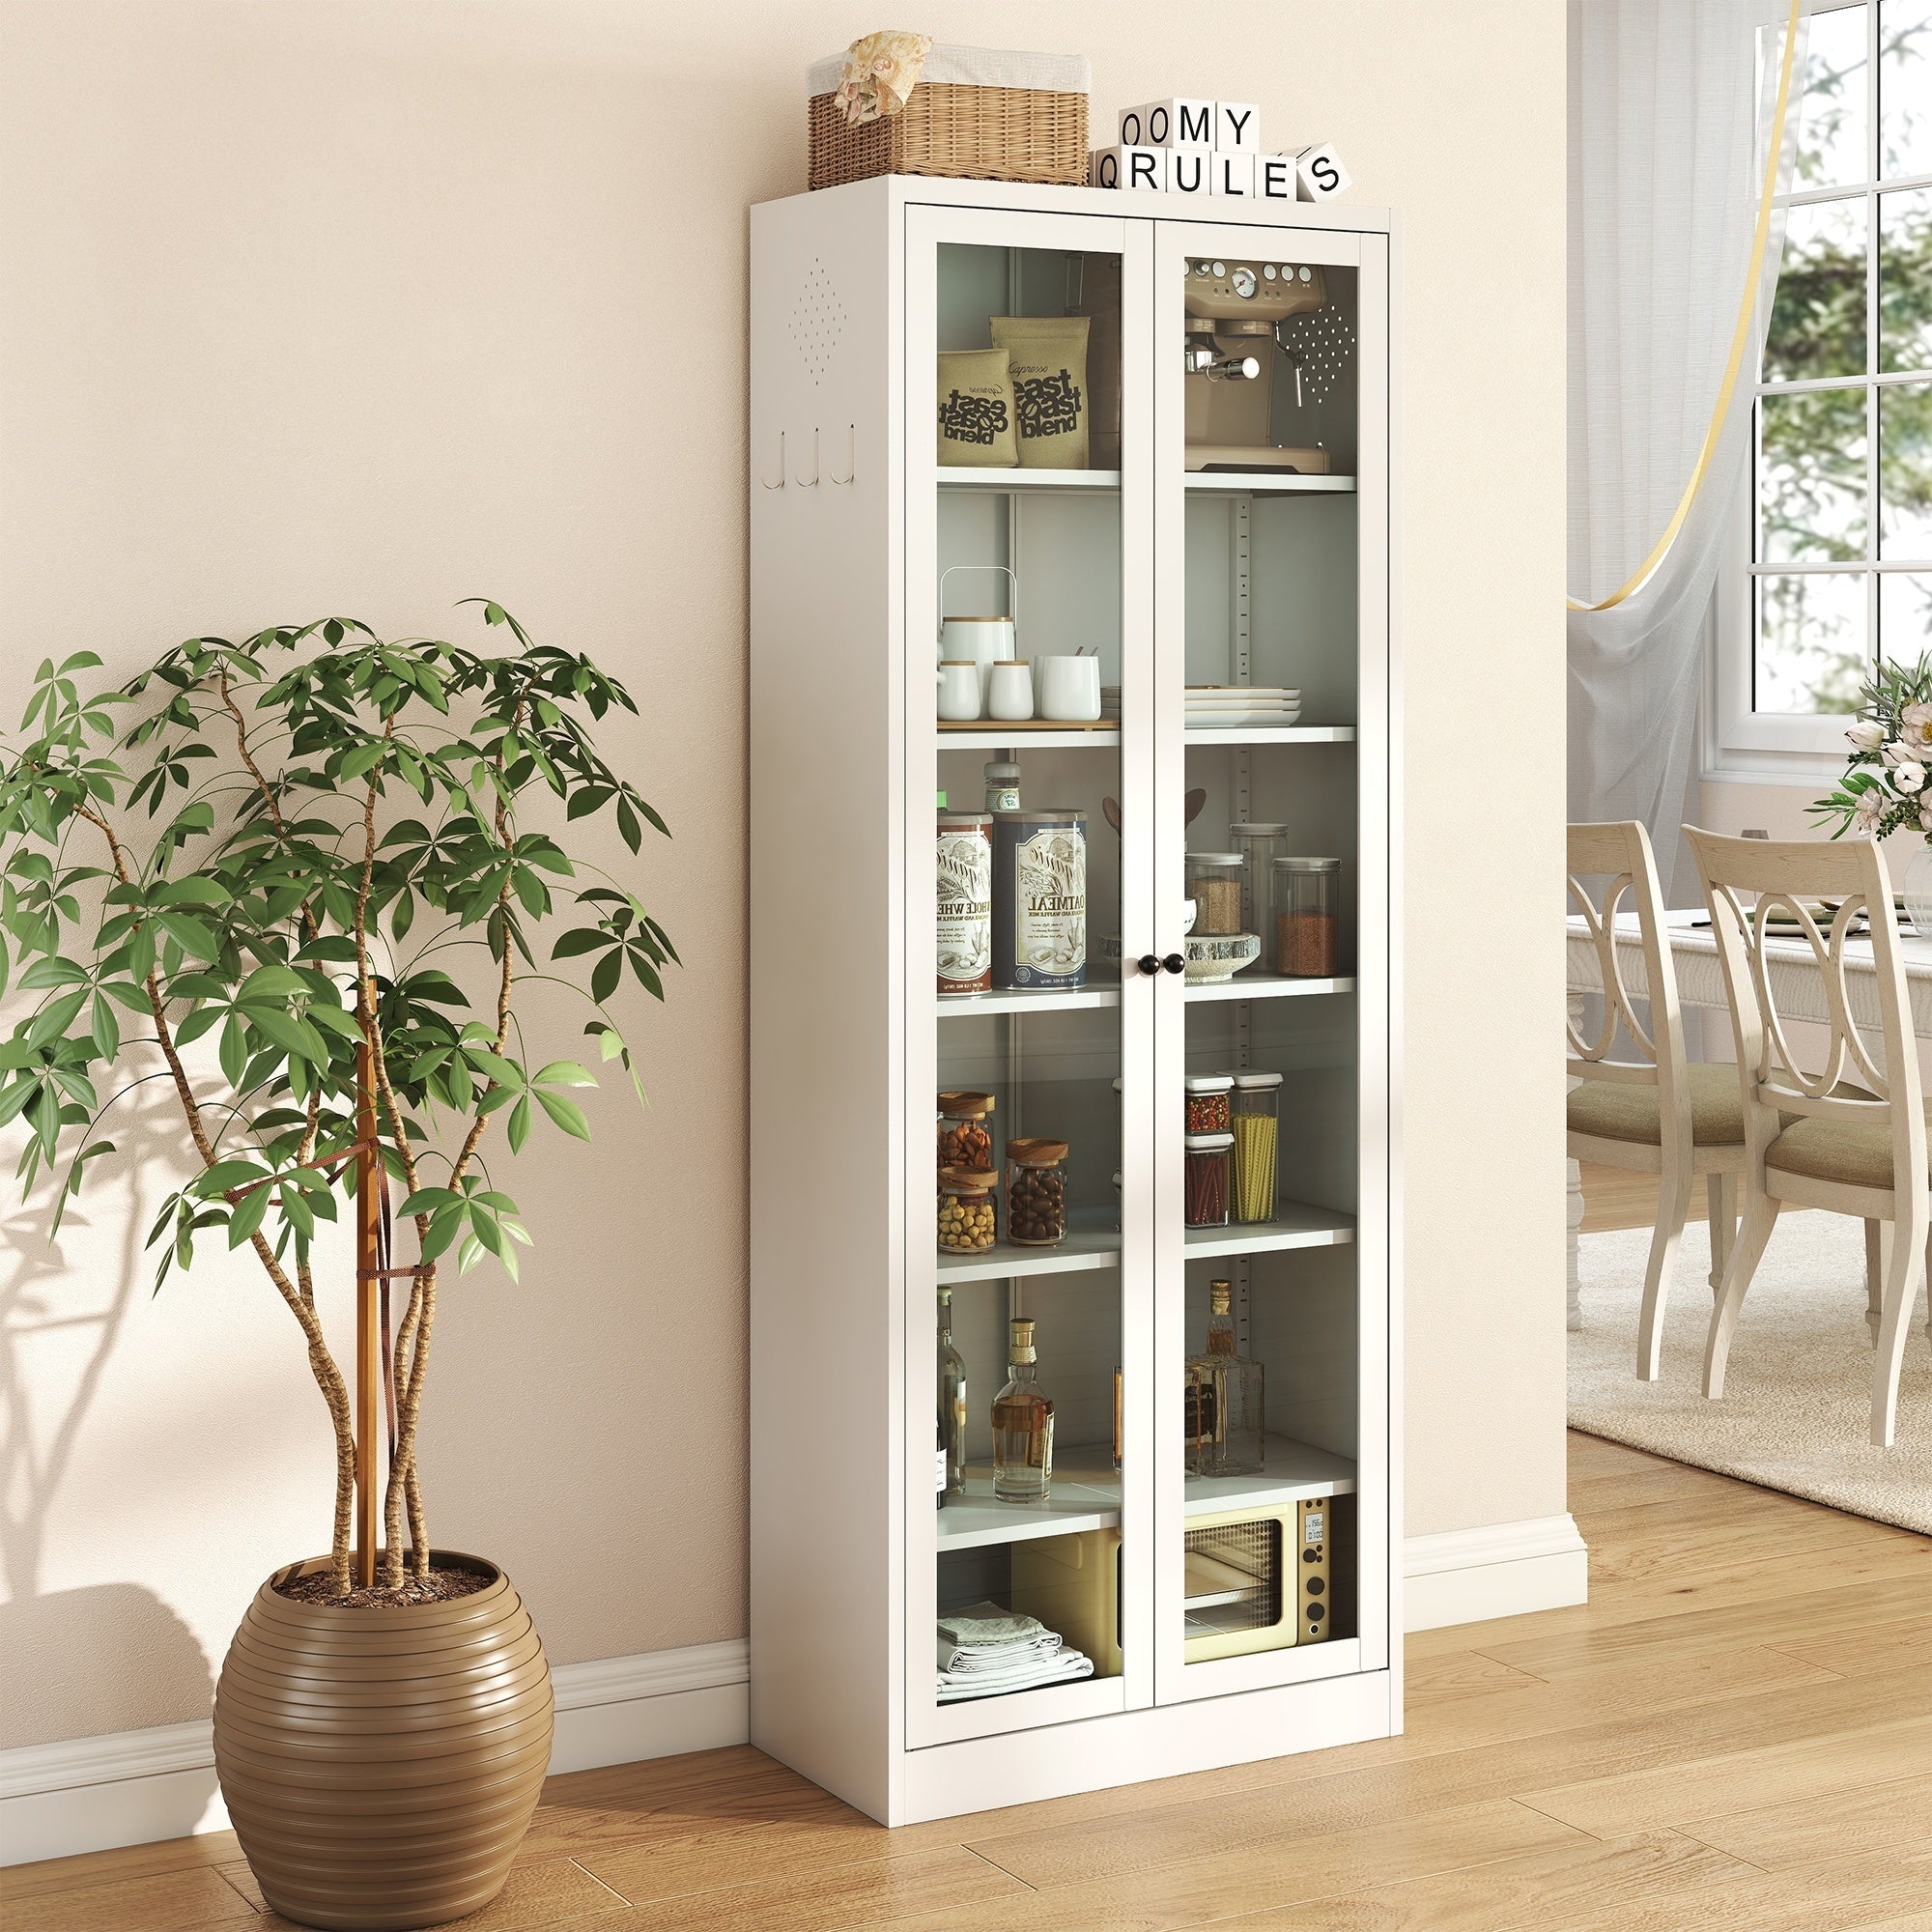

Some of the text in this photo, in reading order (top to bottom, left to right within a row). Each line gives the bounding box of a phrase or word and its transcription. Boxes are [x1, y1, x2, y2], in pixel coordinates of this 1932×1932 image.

[1131, 152, 1340, 198] RULES
[1012, 368, 1071, 402] east
[1020, 411, 1077, 439] blend
